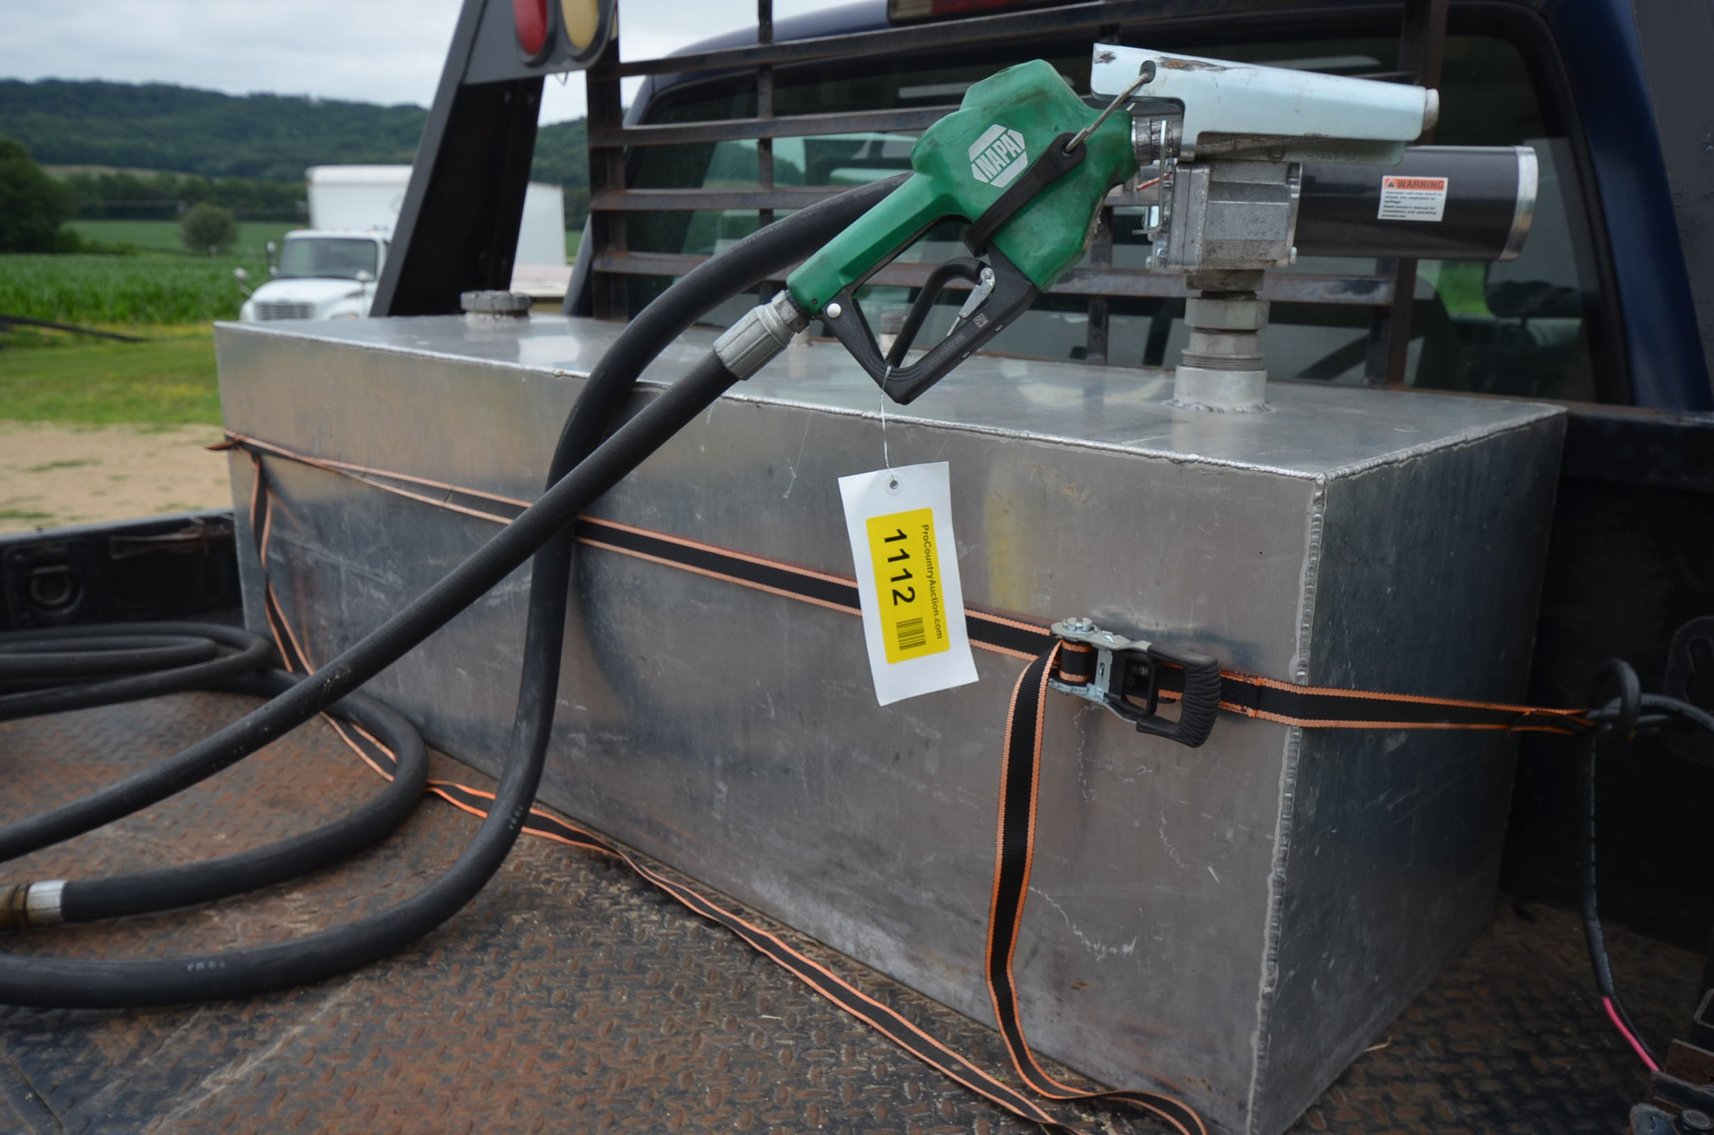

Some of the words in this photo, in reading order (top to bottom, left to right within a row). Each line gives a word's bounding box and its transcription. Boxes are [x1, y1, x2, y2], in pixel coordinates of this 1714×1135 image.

[974, 133, 1023, 181] NAPA
[1397, 179, 1444, 190] WARNING
[884, 528, 916, 607] 1112
[921, 524, 943, 640] ProCountryAuction.com
